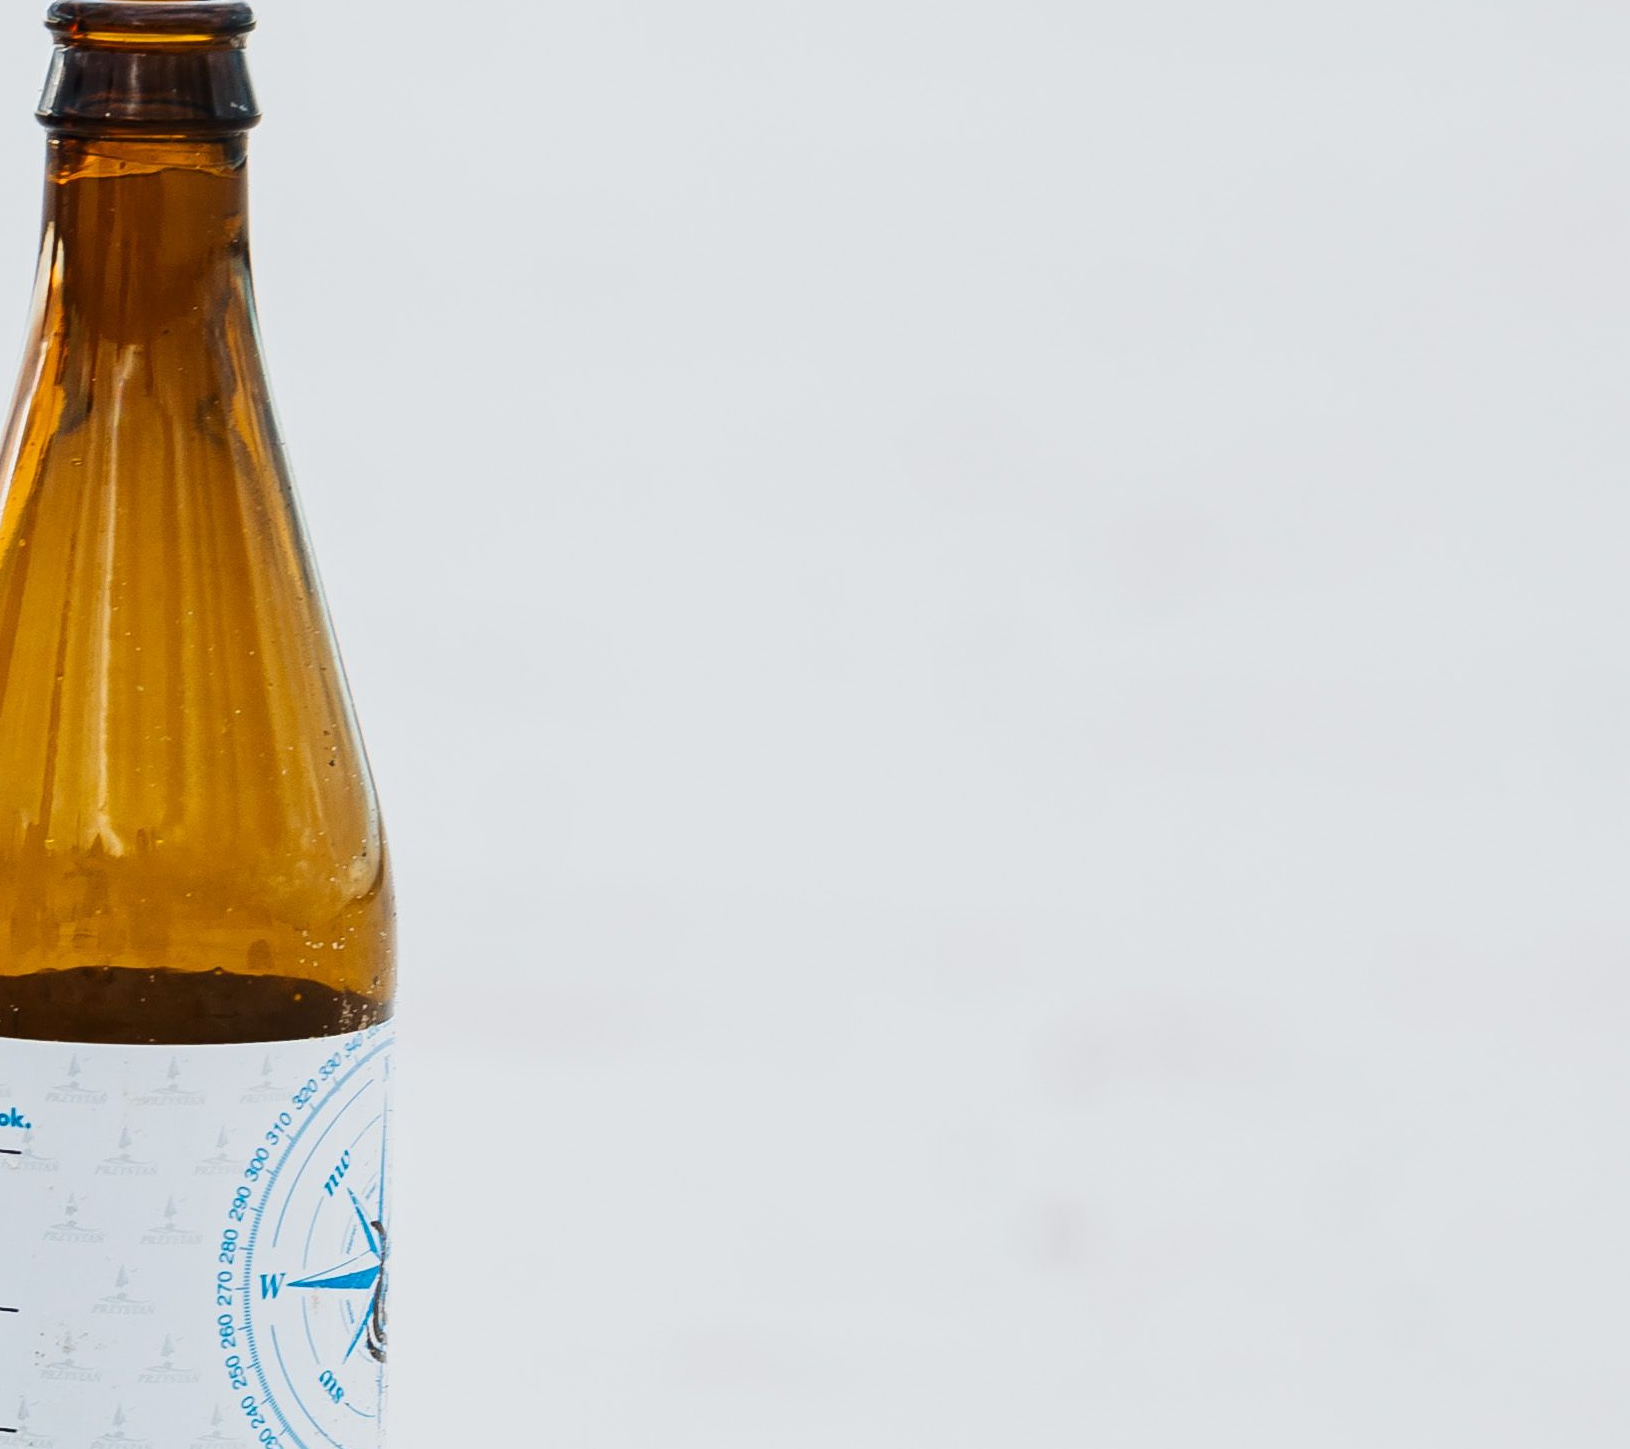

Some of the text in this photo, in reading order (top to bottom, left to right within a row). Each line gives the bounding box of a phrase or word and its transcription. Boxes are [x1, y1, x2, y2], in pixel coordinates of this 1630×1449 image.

[292, 1079, 318, 1110] 320
[266, 1112, 292, 1145] 310
[244, 1148, 270, 1182] 300
[228, 1186, 252, 1222] 290
[219, 1229, 238, 1264] 280
[217, 1271, 232, 1305] 270
[259, 1272, 286, 1300] W
[217, 1313, 236, 1349] 260
[225, 1355, 247, 1390] 250
[241, 1396, 266, 1429] 240
